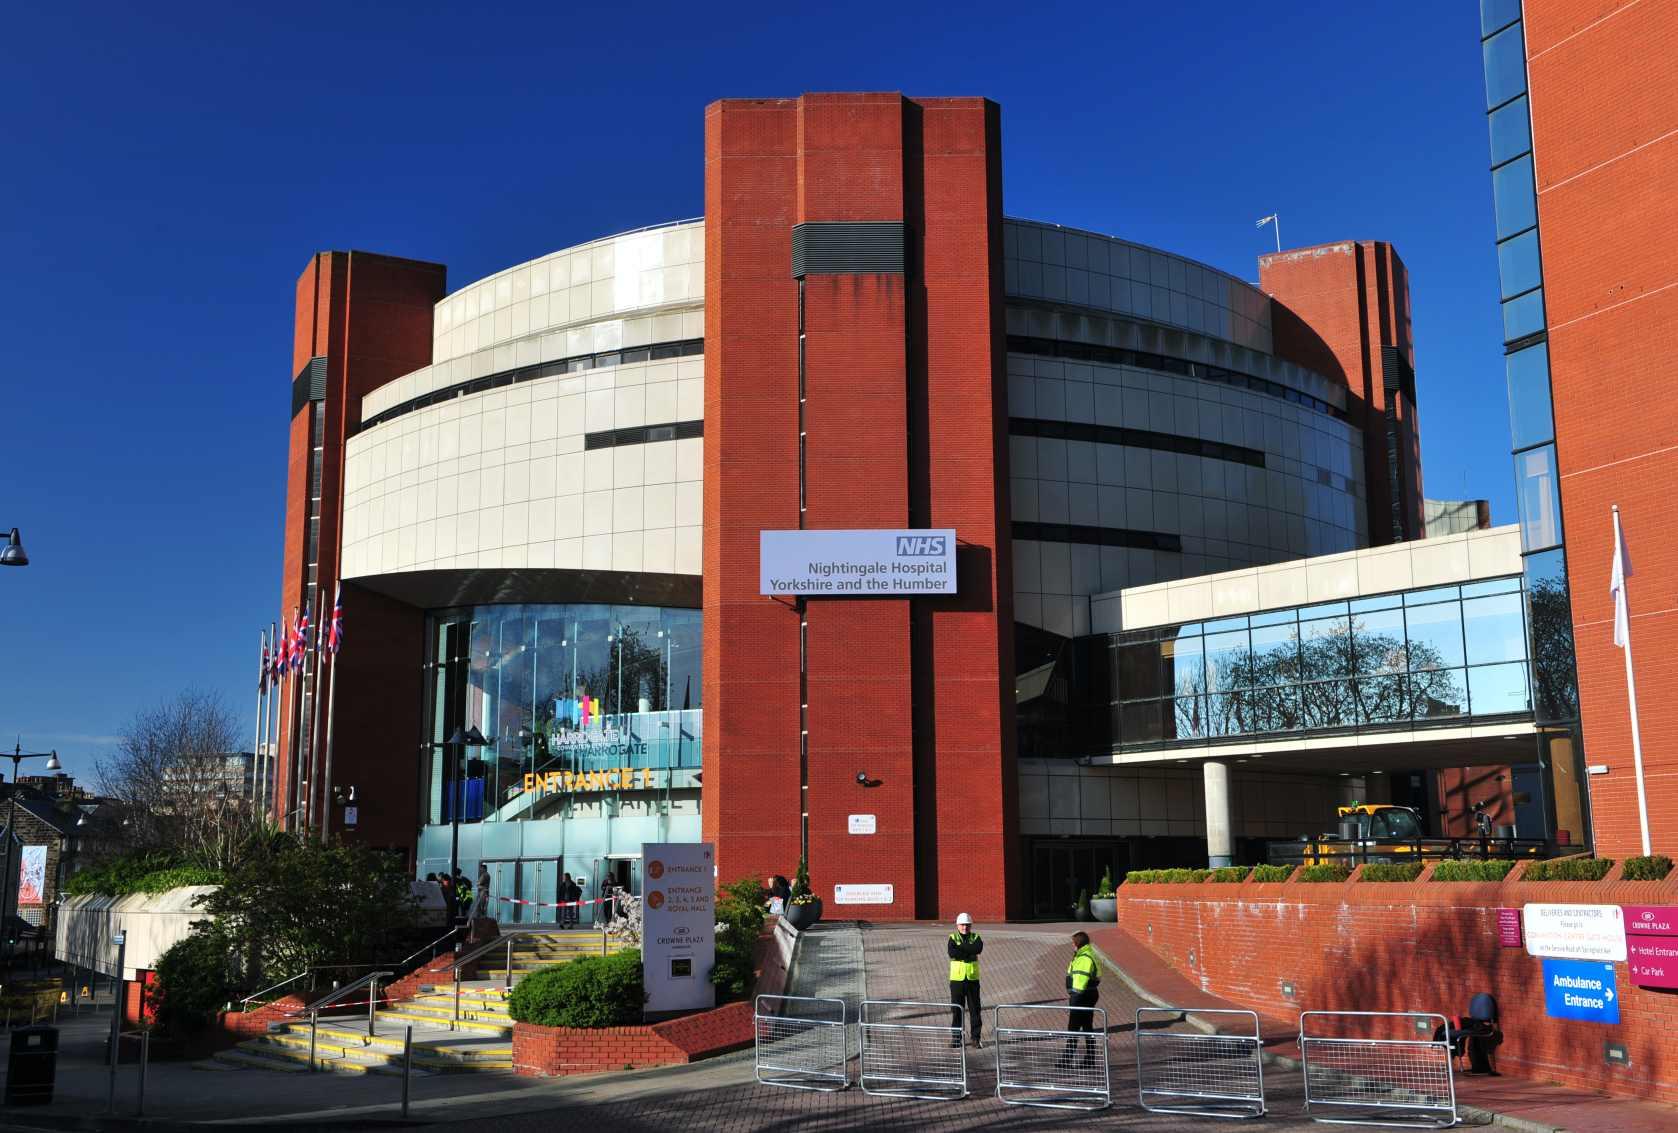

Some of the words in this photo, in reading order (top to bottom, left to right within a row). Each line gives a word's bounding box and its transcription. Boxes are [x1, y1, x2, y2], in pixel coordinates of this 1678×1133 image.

[897, 537, 946, 555] NHS
[809, 562, 887, 576] Nightingale
[891, 561, 947, 576] Hospital
[770, 578, 832, 590] Yorkshire
[836, 578, 862, 590] and
[866, 578, 889, 590] the
[893, 577, 947, 590] Humber
[524, 768, 634, 793] ENTRANCE
[667, 865, 702, 873] ENTRANCE
[696, 895, 709, 903] AND
[1632, 921, 1651, 930] CROWNE
[1652, 922, 1671, 930] PLAZA
[657, 936, 683, 944] CROWNE
[685, 936, 704, 944] PLAZA
[1639, 946, 1655, 956] Hotel
[1641, 967, 1651, 976] Car
[1652, 967, 1665, 977] Park
[1553, 974, 1602, 990] Ambulance
[1564, 992, 1604, 1009] Entrance
